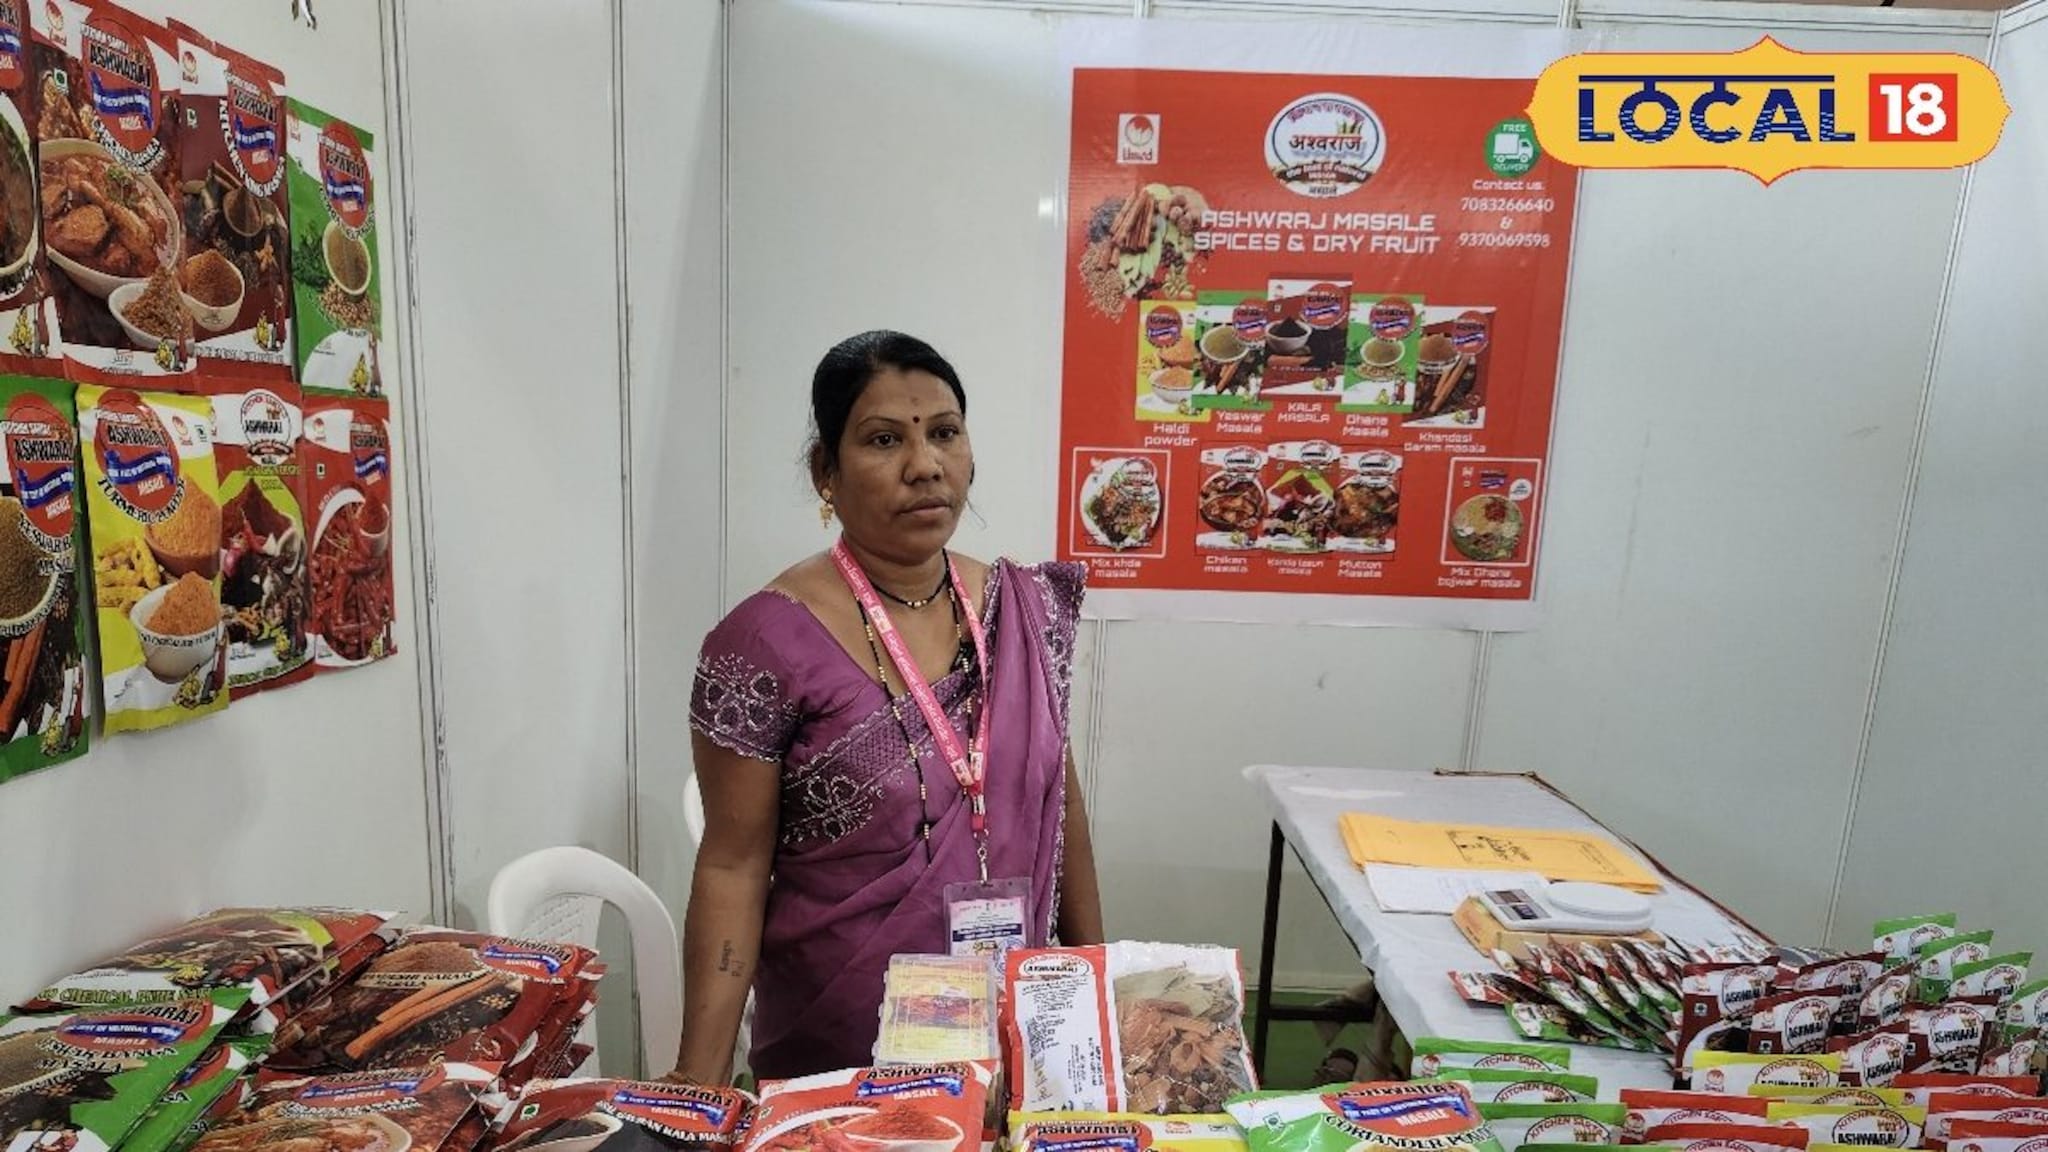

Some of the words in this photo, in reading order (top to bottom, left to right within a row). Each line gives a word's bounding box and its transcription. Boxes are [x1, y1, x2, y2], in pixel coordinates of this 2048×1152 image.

[1503, 123, 1528, 132] FREE
[1472, 180, 1524, 190] Contact
[1461, 198, 1555, 212] 7083266640
[1201, 210, 1327, 230] ASHWRAJ
[1333, 213, 1436, 232] MASALE
[1500, 216, 1513, 230] &
[1193, 232, 1281, 251] SPICES
[1287, 233, 1305, 252] &
[1313, 235, 1364, 252] DRY
[1370, 236, 1441, 253] FRUIT
[1459, 233, 1551, 247] 9370069598
[1288, 402, 1322, 412] KALA
[1278, 413, 1330, 422] MASALA
[1153, 423, 1191, 434] Haldi
[1144, 435, 1198, 447] powder
[1091, 559, 1111, 567] Mix
[1339, 559, 1382, 569] Mutton
[1095, 569, 1137, 578] masala
[1451, 568, 1471, 577] Mix
[893, 1088, 938, 1101] MASALE
[1498, 1083, 1541, 1102] KITCHEN
[1395, 1108, 1450, 1127] MASALE
[1325, 1115, 1442, 1151] CORIANDER
[1530, 1117, 1571, 1139] KITCHEN
